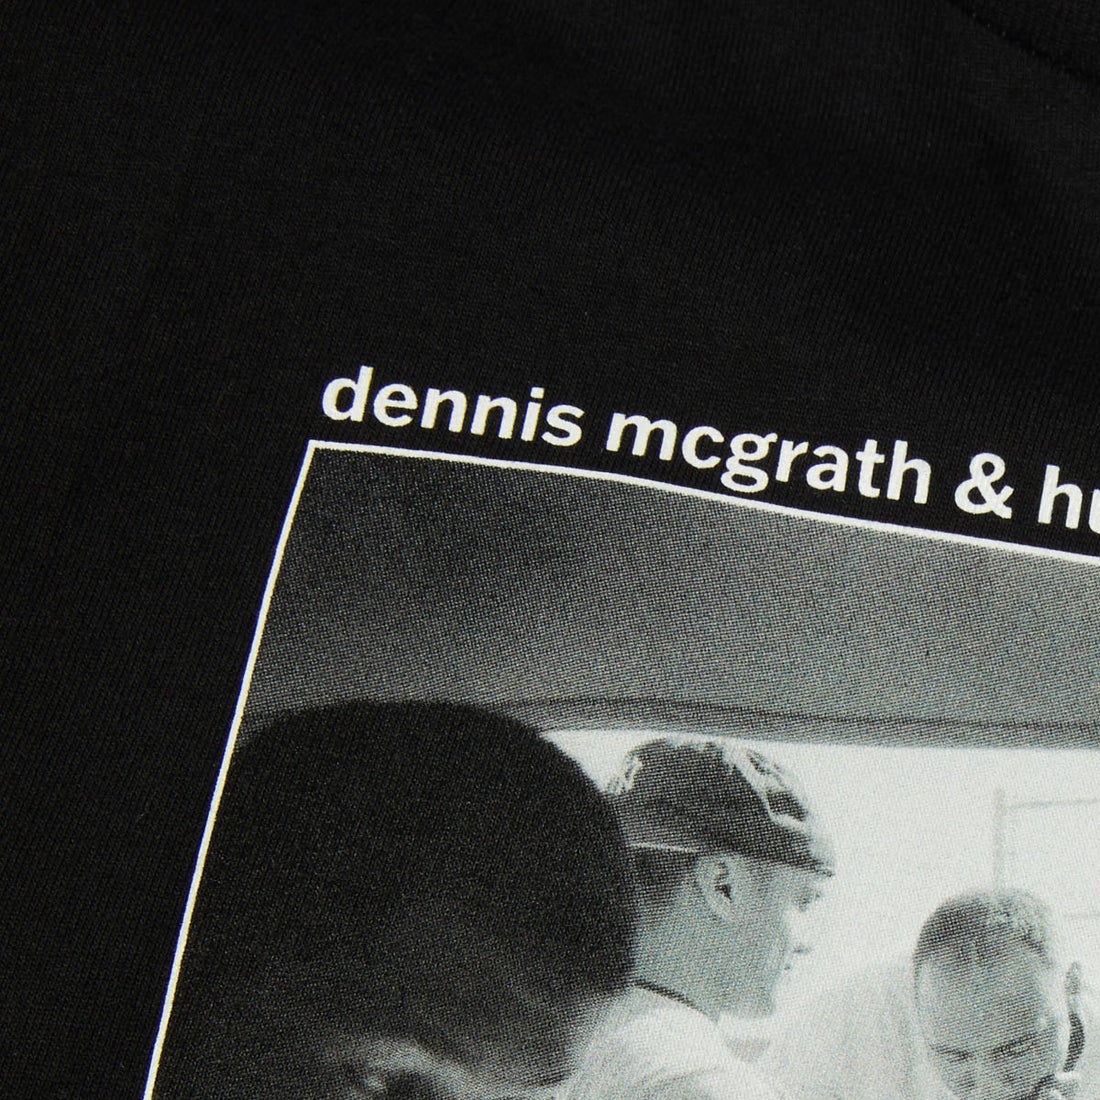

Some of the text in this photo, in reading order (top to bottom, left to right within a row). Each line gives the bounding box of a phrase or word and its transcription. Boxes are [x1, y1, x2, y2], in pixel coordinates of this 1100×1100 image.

[321, 365, 585, 447] dennis
[605, 412, 932, 505] mcgrath
[954, 452, 1015, 520] &
